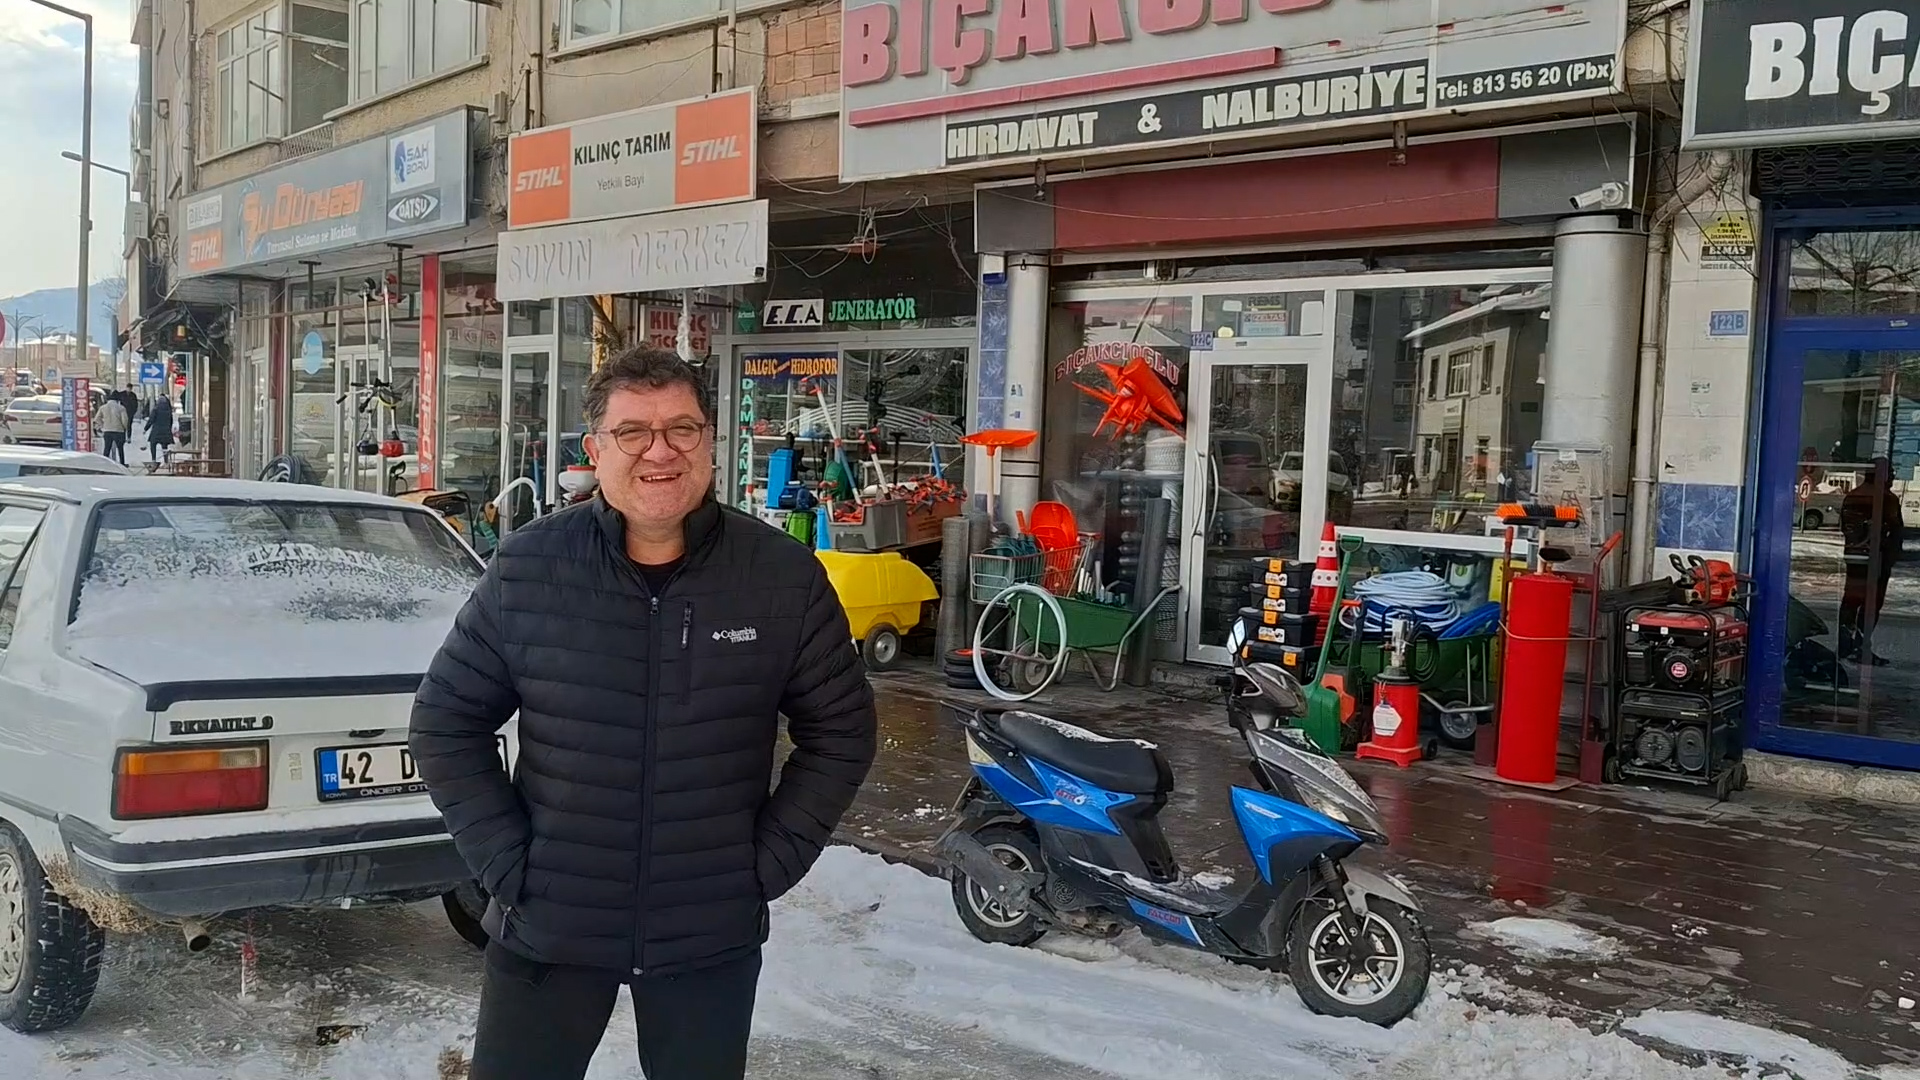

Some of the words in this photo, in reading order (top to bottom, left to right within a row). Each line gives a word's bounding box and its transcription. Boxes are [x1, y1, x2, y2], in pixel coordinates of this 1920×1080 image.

[1745, 10, 1920, 115] BIÇ
[1437, 82, 1468, 101] Tel:
[1473, 76, 1505, 95] 813
[1510, 72, 1533, 90] 56
[1538, 68, 1561, 86] 20
[1565, 59, 1616, 88] (Pbx)
[948, 111, 1098, 159] HIRDAVAT
[1137, 103, 1162, 133] &
[1202, 65, 1426, 129] NALBURİYE
[574, 140, 621, 165] KILINÇ
[625, 131, 671, 156] TARIM
[680, 135, 742, 165] STIHL
[515, 166, 564, 192] STIHL
[597, 177, 623, 191] Yetkili
[624, 173, 644, 188] Bayi
[399, 198, 428, 219] DATSU
[190, 236, 219, 262] STIHL
[829, 293, 916, 321] JENERATÖR
[744, 358, 779, 379] DALGIÇ
[421, 351, 433, 460] petlas
[720, 626, 757, 638] Columbia
[169, 717, 256, 735] RENAULT
[323, 773, 338, 783] TR
[341, 752, 374, 784] 42
